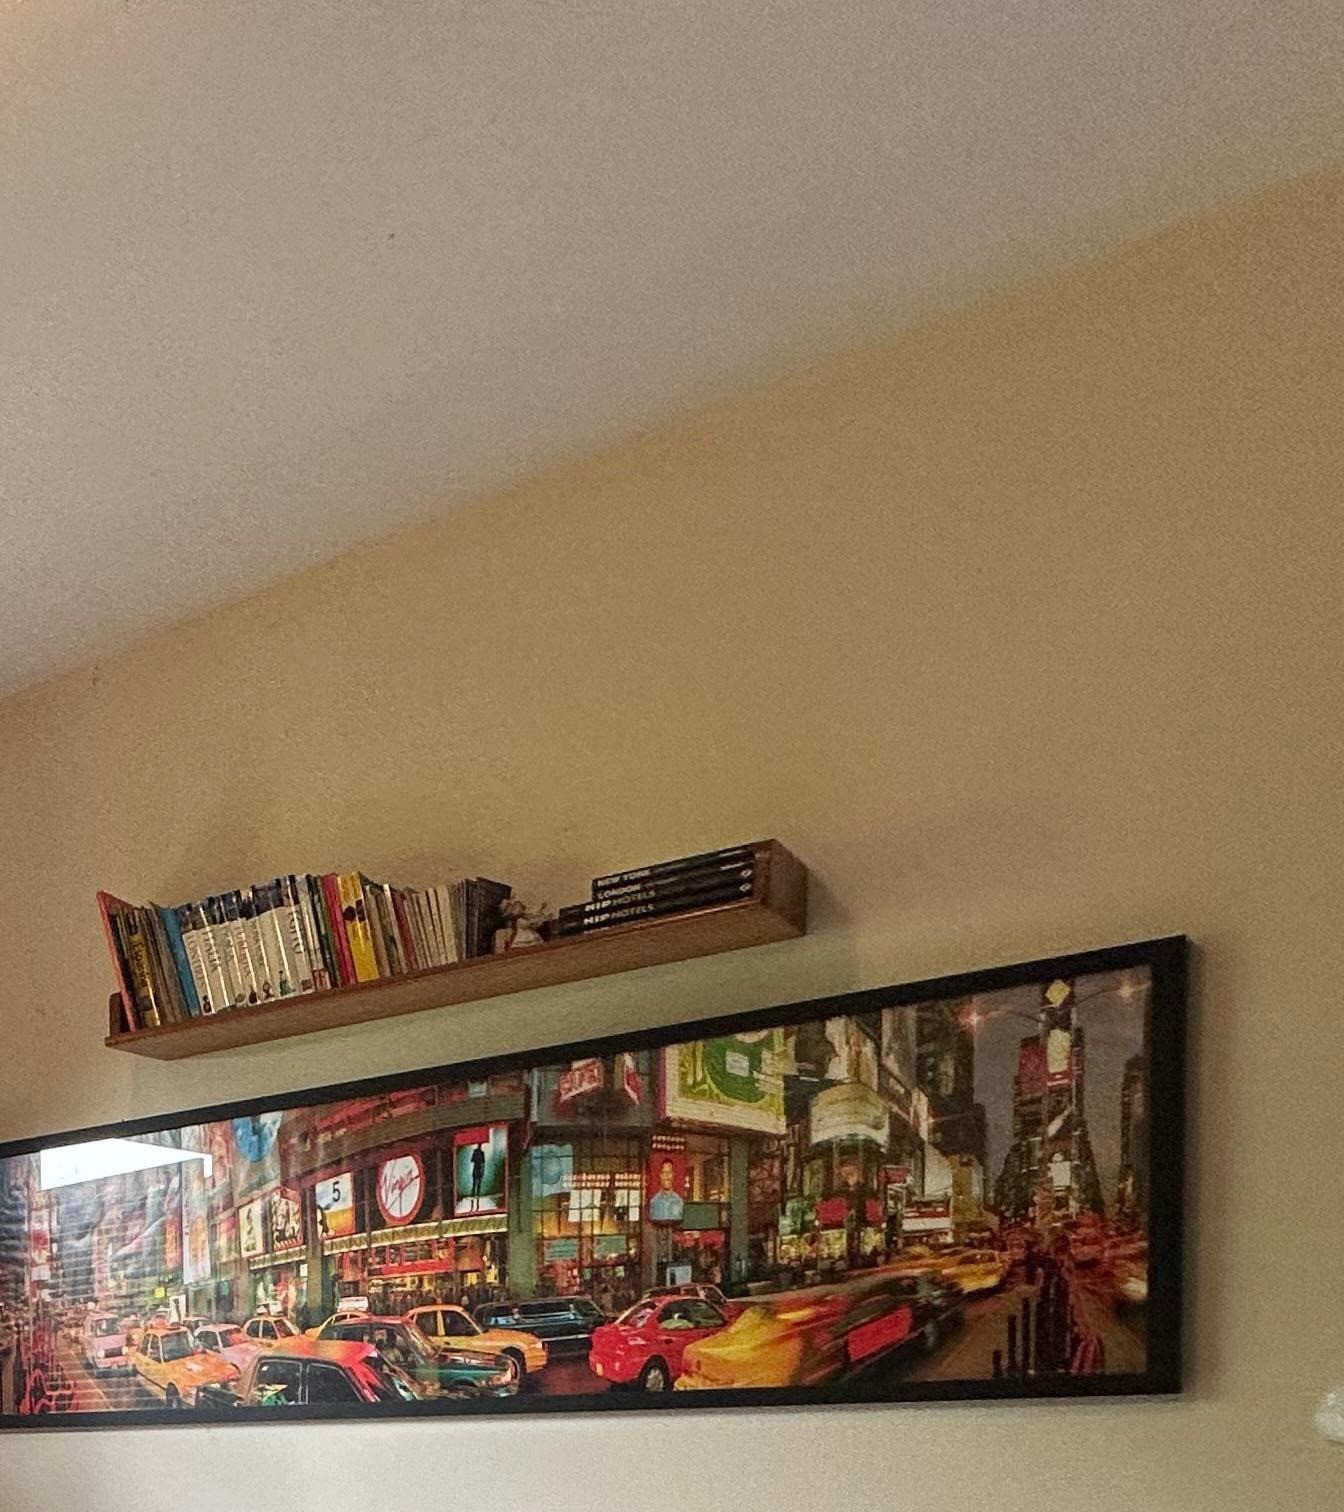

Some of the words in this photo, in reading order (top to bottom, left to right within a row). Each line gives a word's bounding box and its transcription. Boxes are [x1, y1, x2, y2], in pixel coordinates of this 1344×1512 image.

[597, 884, 642, 900] LONDON
[612, 890, 656, 906] HOTELS
[583, 914, 611, 925] HIP
[612, 904, 655, 919] HOTELS
[329, 1180, 343, 1206] 5
